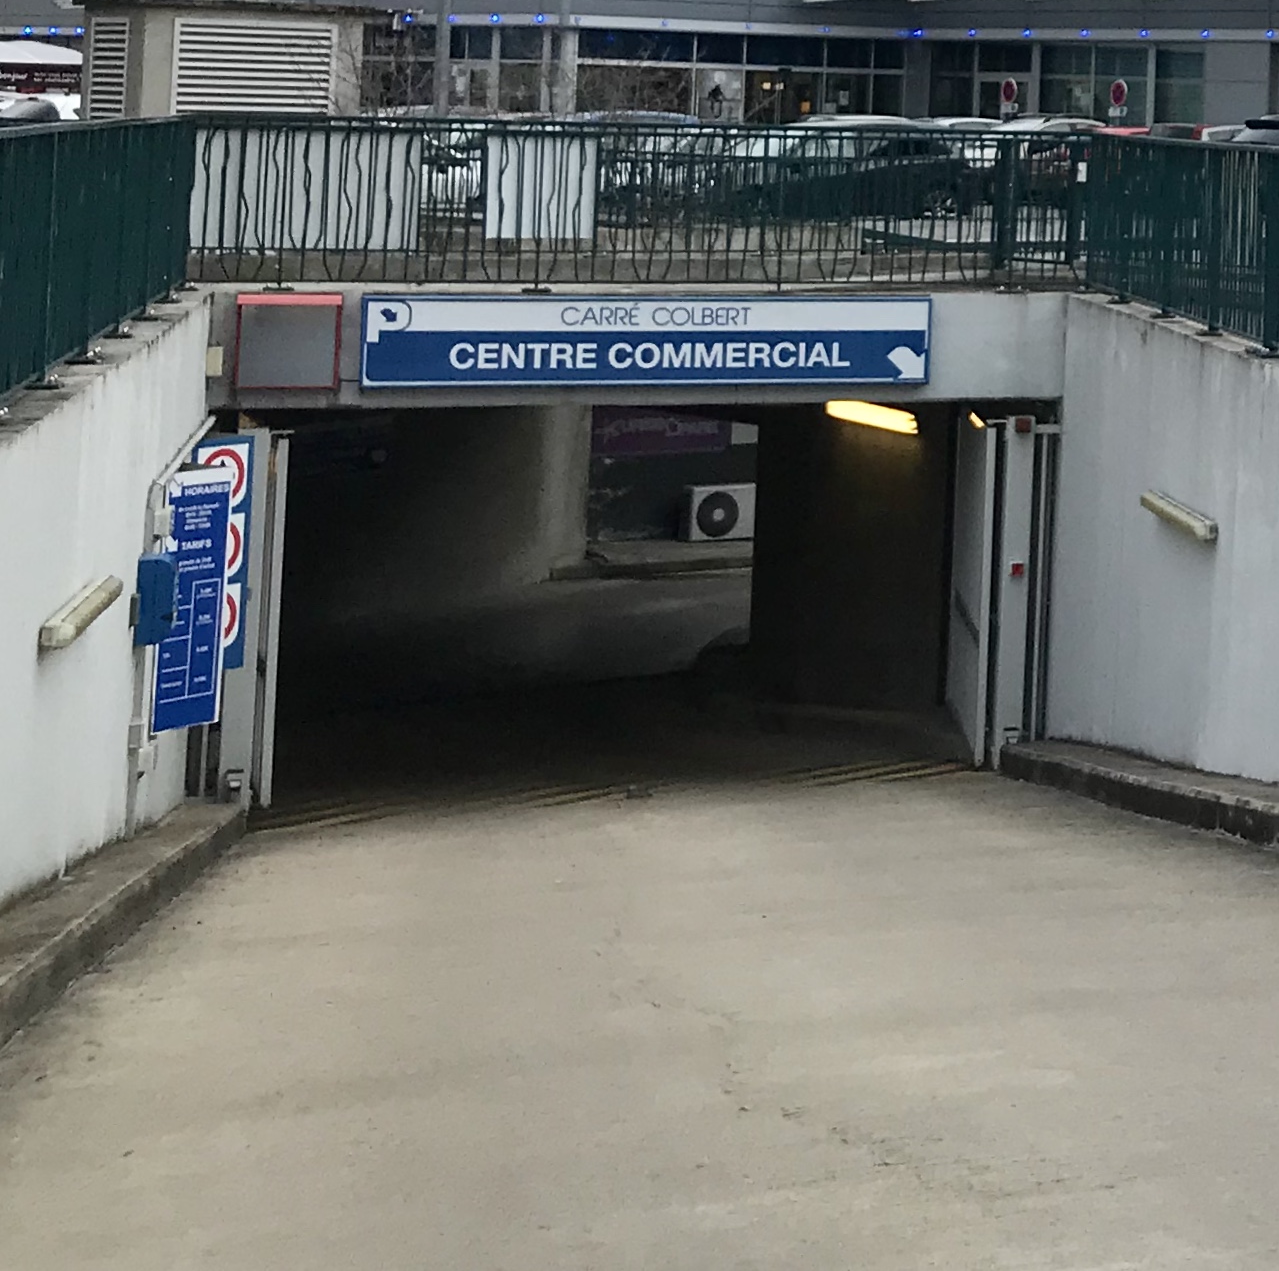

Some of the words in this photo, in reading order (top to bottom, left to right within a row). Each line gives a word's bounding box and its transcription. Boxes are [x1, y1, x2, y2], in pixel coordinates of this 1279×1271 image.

[560, 303, 641, 326] CARRÉ
[651, 306, 752, 326] COLBERT
[449, 342, 598, 370] CENTRE
[607, 341, 850, 369] COMMERCIAL
[184, 483, 231, 496] HORAIRES
[181, 538, 212, 551] TARIFS
